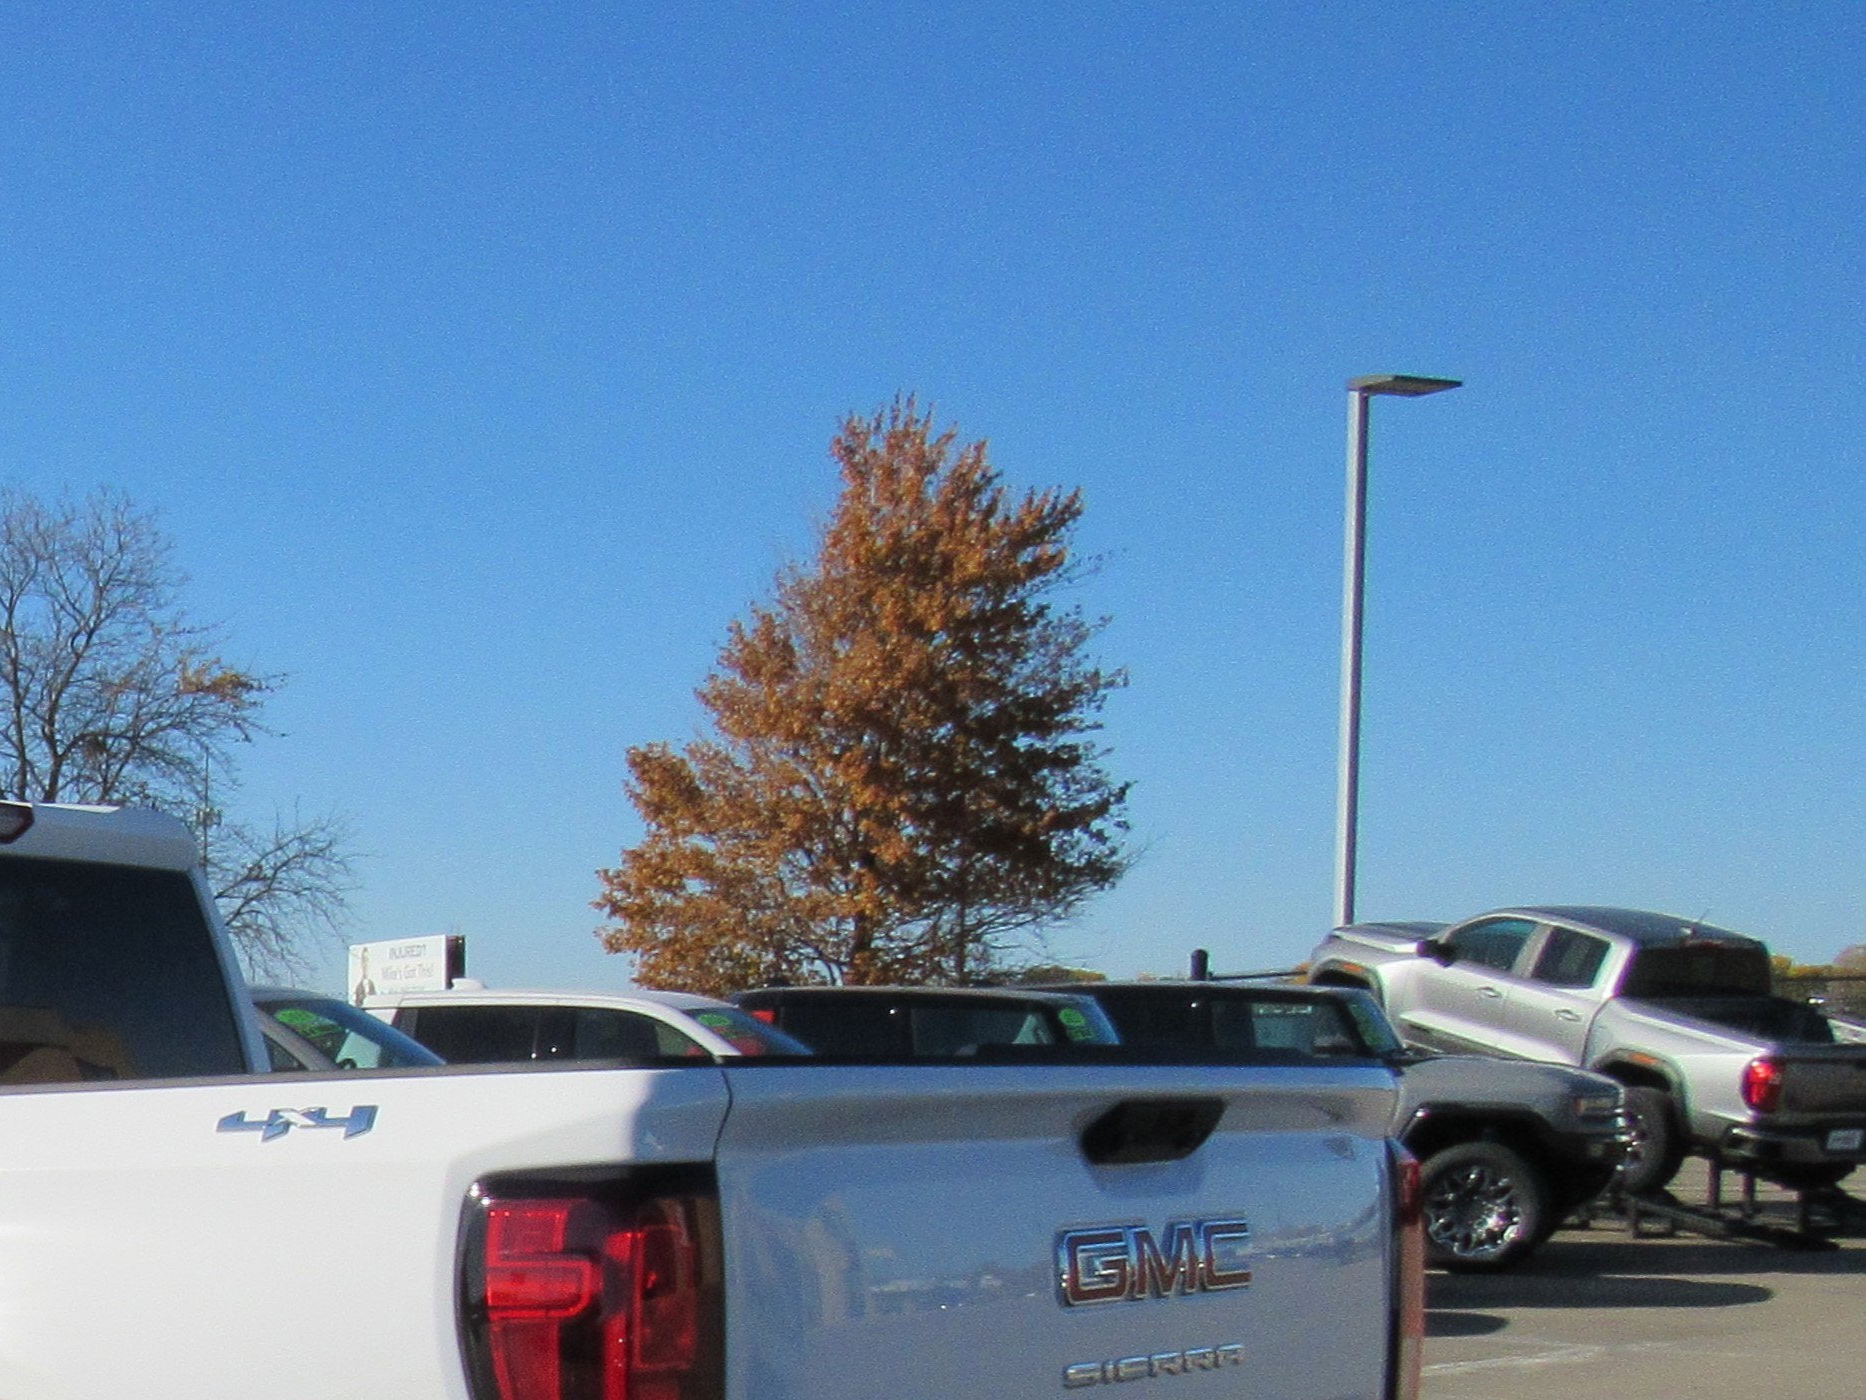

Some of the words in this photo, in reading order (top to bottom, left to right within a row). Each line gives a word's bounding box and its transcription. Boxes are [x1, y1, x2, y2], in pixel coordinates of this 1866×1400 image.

[388, 944, 427, 959] INJURED?
[1054, 1216, 1253, 1308] GMC
[1062, 1343, 1245, 1389] SIERRA
